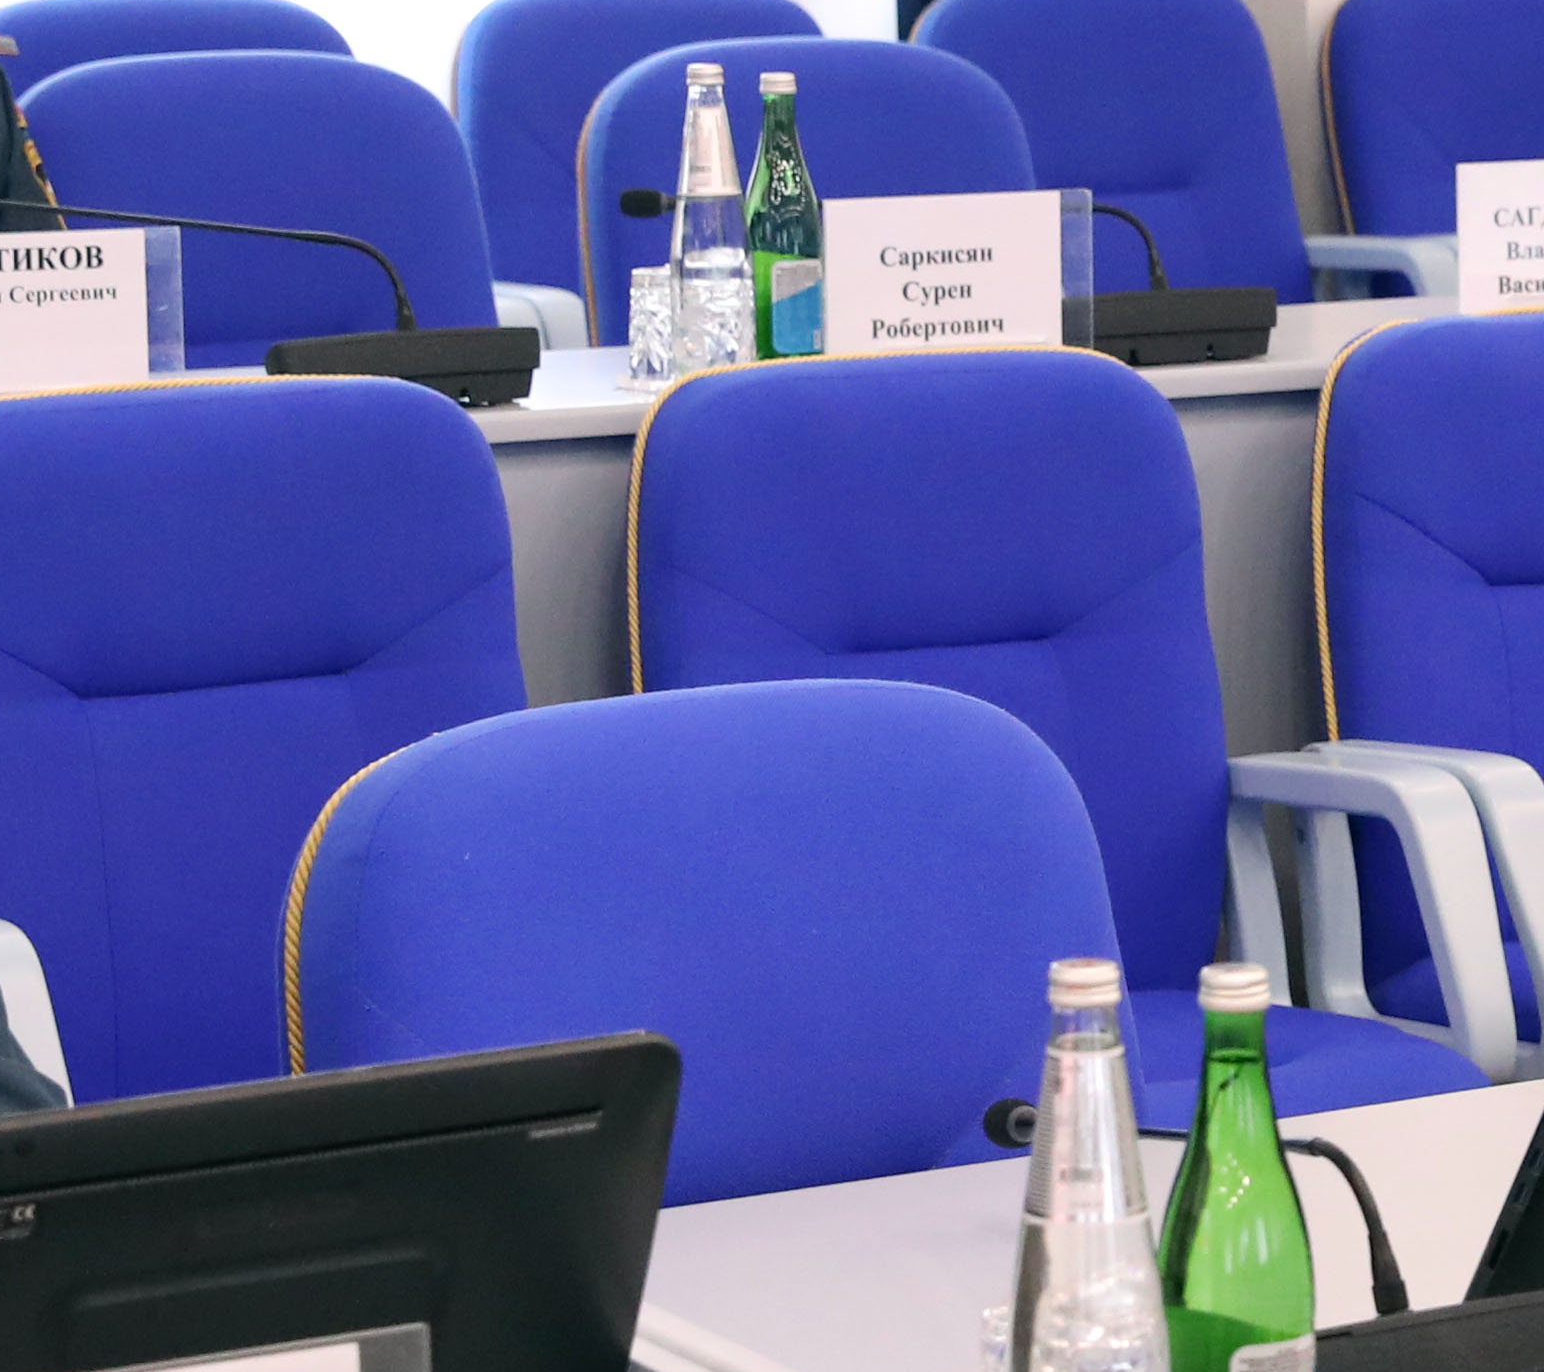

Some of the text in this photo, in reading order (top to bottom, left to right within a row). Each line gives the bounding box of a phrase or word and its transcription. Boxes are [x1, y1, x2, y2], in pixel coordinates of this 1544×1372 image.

[879, 245, 994, 271] Саркисян
[8, 285, 118, 308] Сергеевич
[902, 280, 973, 307] Сурен
[870, 316, 1005, 342] Робертович
